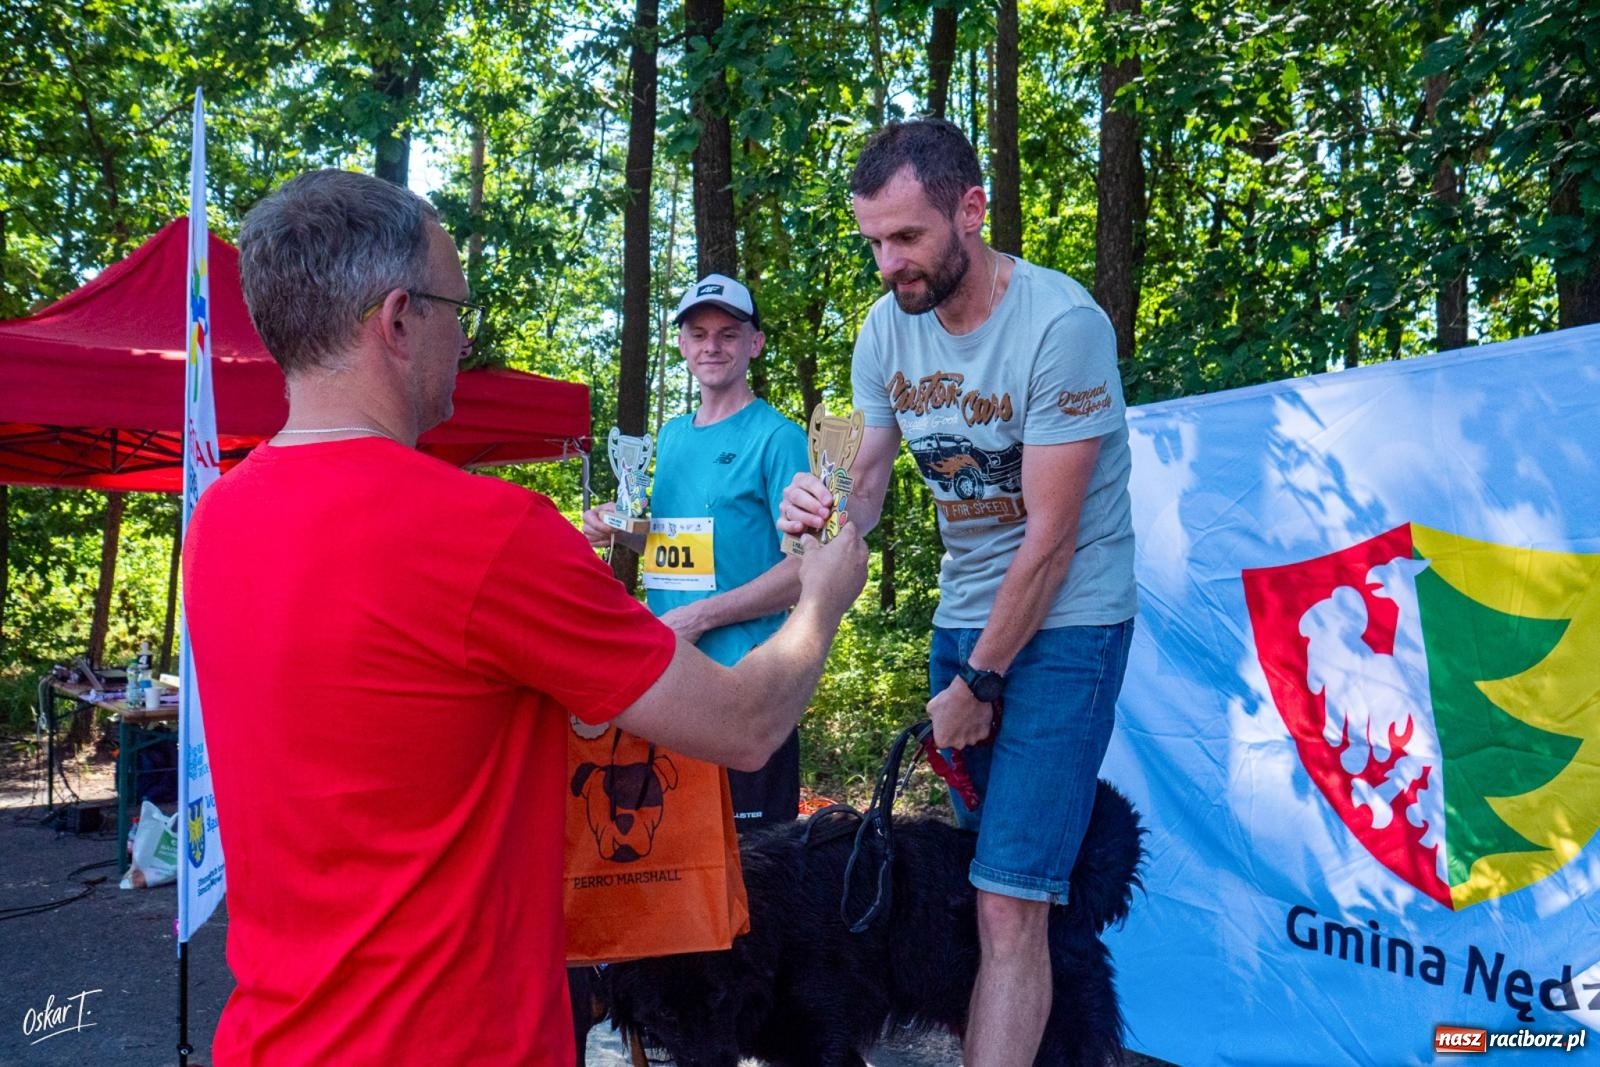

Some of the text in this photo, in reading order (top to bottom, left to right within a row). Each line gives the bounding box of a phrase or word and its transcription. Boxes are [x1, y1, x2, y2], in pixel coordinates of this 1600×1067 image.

[1057, 379, 1107, 408] Original
[961, 389, 1013, 428] Cars
[952, 503, 970, 516] FOR
[973, 500, 1009, 515] SPEED
[655, 545, 695, 568] 001
[573, 869, 682, 890] PERRO MARSHALL
[1286, 904, 1446, 986] Gmina
